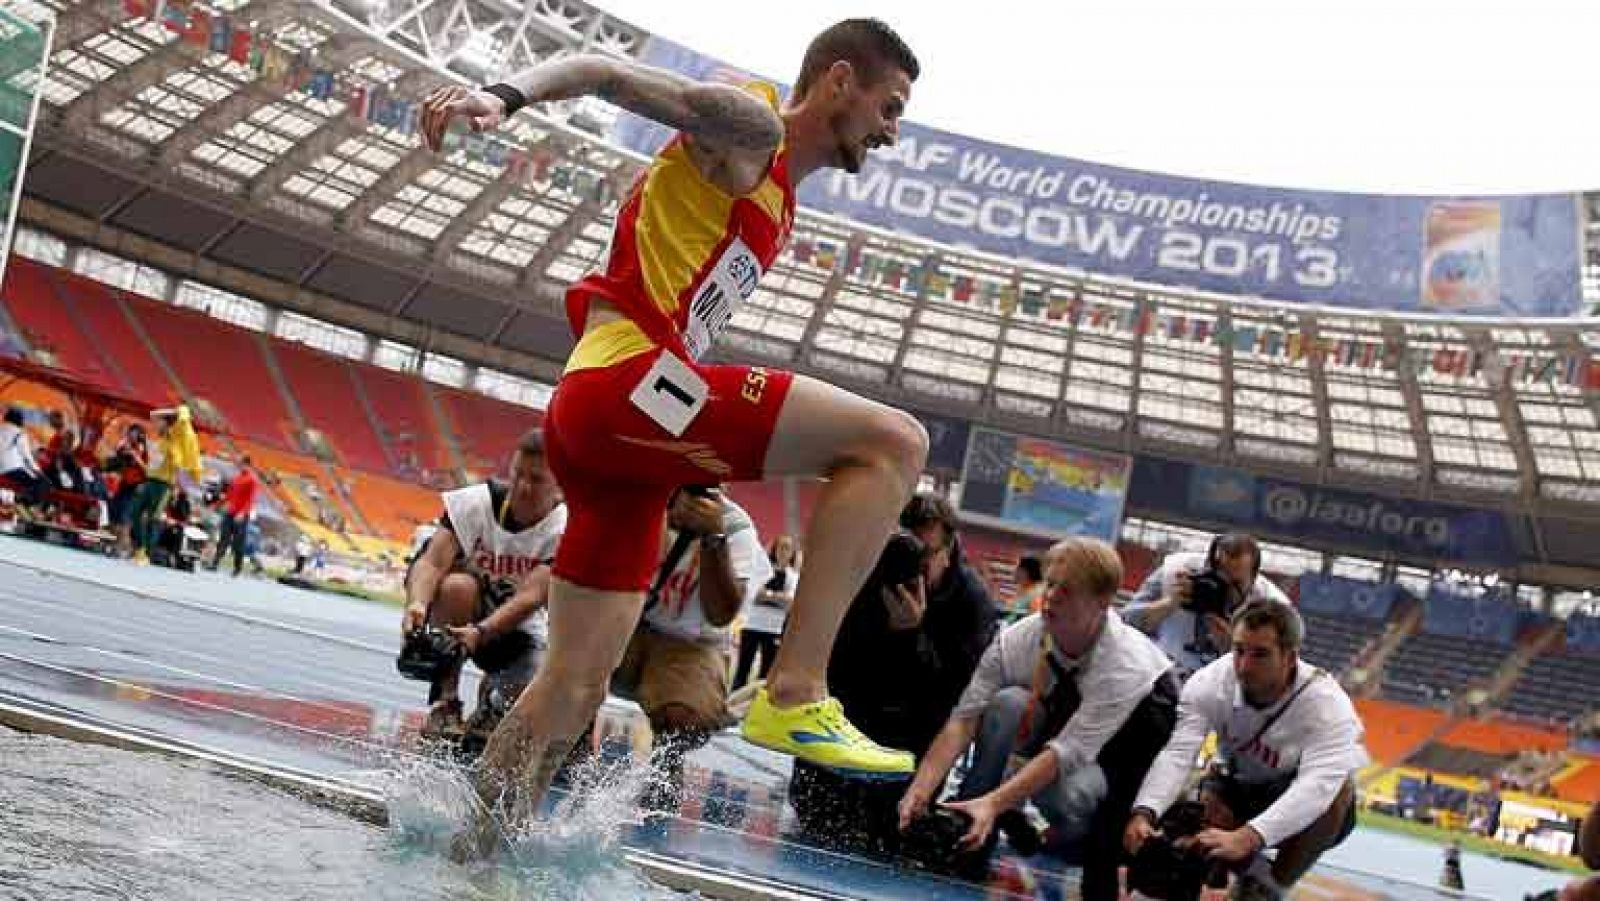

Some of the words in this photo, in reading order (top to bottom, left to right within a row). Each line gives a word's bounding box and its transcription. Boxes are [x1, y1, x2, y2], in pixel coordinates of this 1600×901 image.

[828, 167, 1144, 261] MOSCOW
[1157, 230, 1339, 288] 2013
[960, 151, 1066, 199] World
[1068, 173, 1341, 244] Championships
[653, 374, 697, 408] 1
[741, 366, 767, 404] ES
[1266, 485, 1450, 546] @iaaforg
